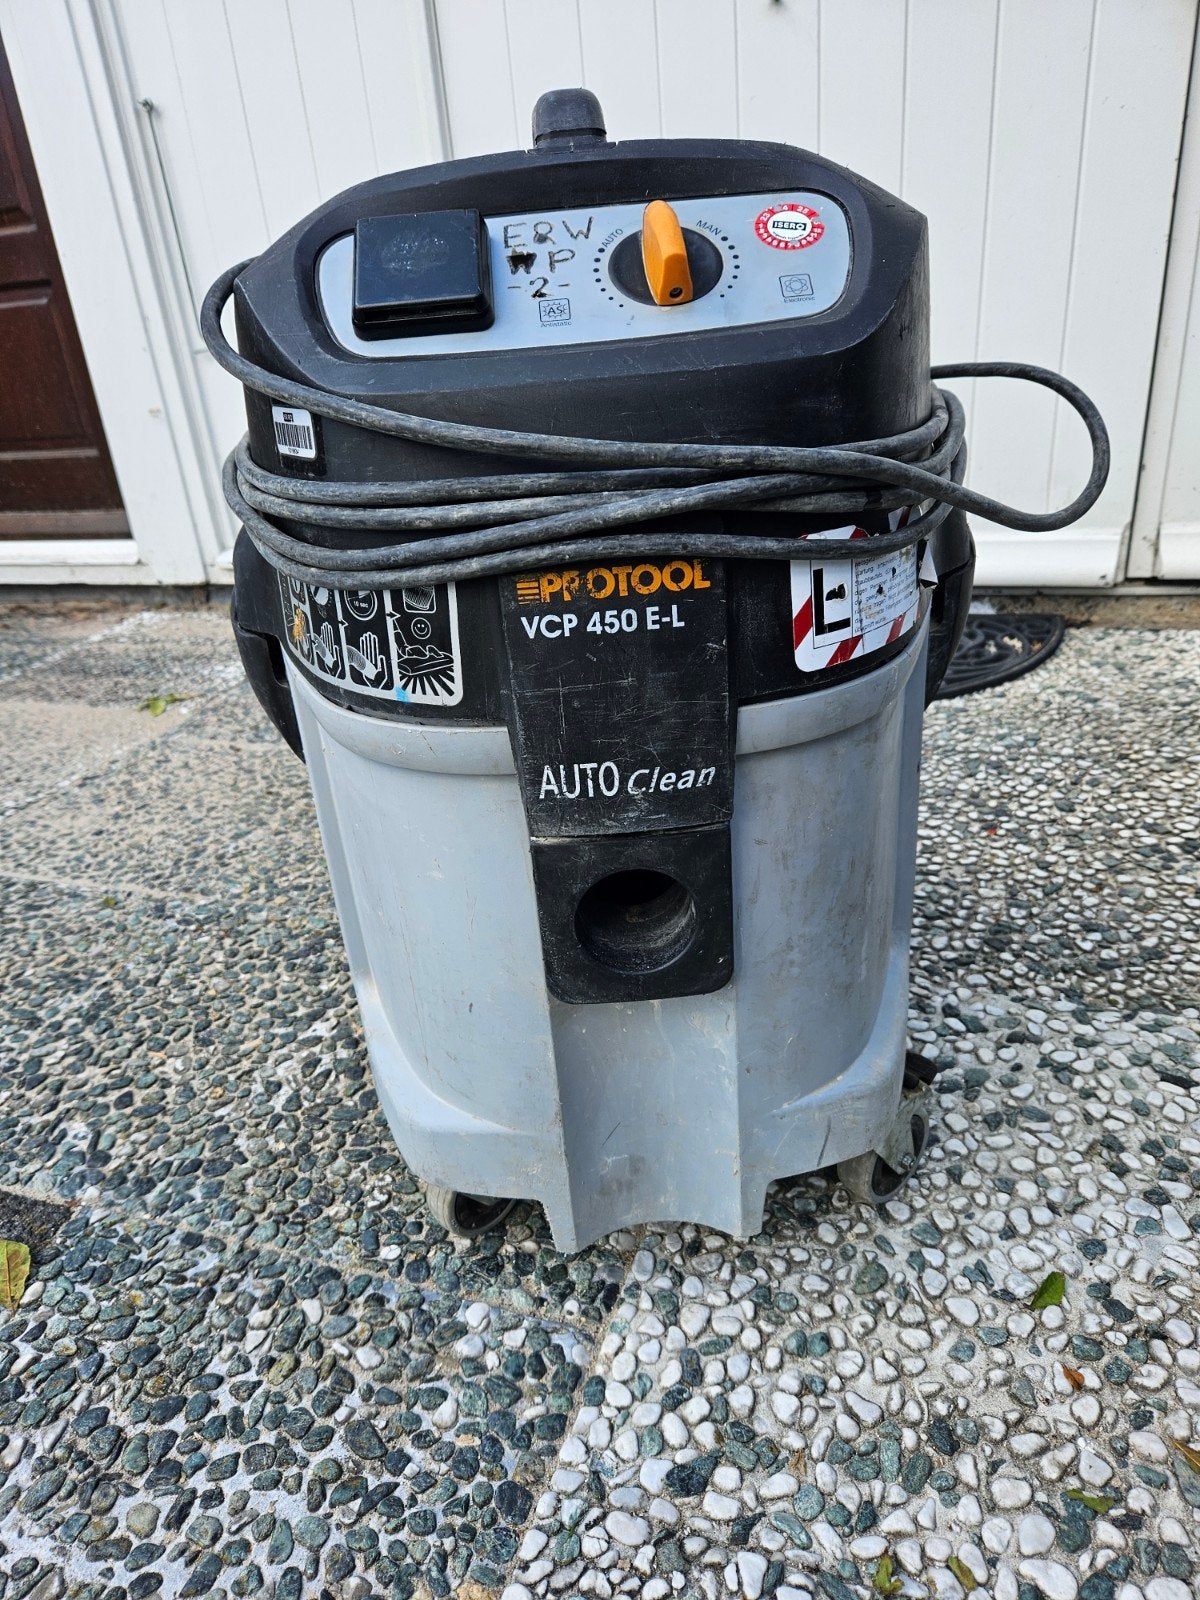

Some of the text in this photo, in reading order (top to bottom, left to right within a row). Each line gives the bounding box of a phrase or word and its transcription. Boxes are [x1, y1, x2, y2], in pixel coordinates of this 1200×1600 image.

[695, 219, 722, 236] MAN
[773, 221, 805, 231] ISERO
[601, 228, 624, 248] AUTO
[547, 307, 563, 315] AS
[813, 568, 851, 637] L
[521, 604, 685, 639] VCP 450 E-L
[539, 760, 717, 800] AUTO Clean
